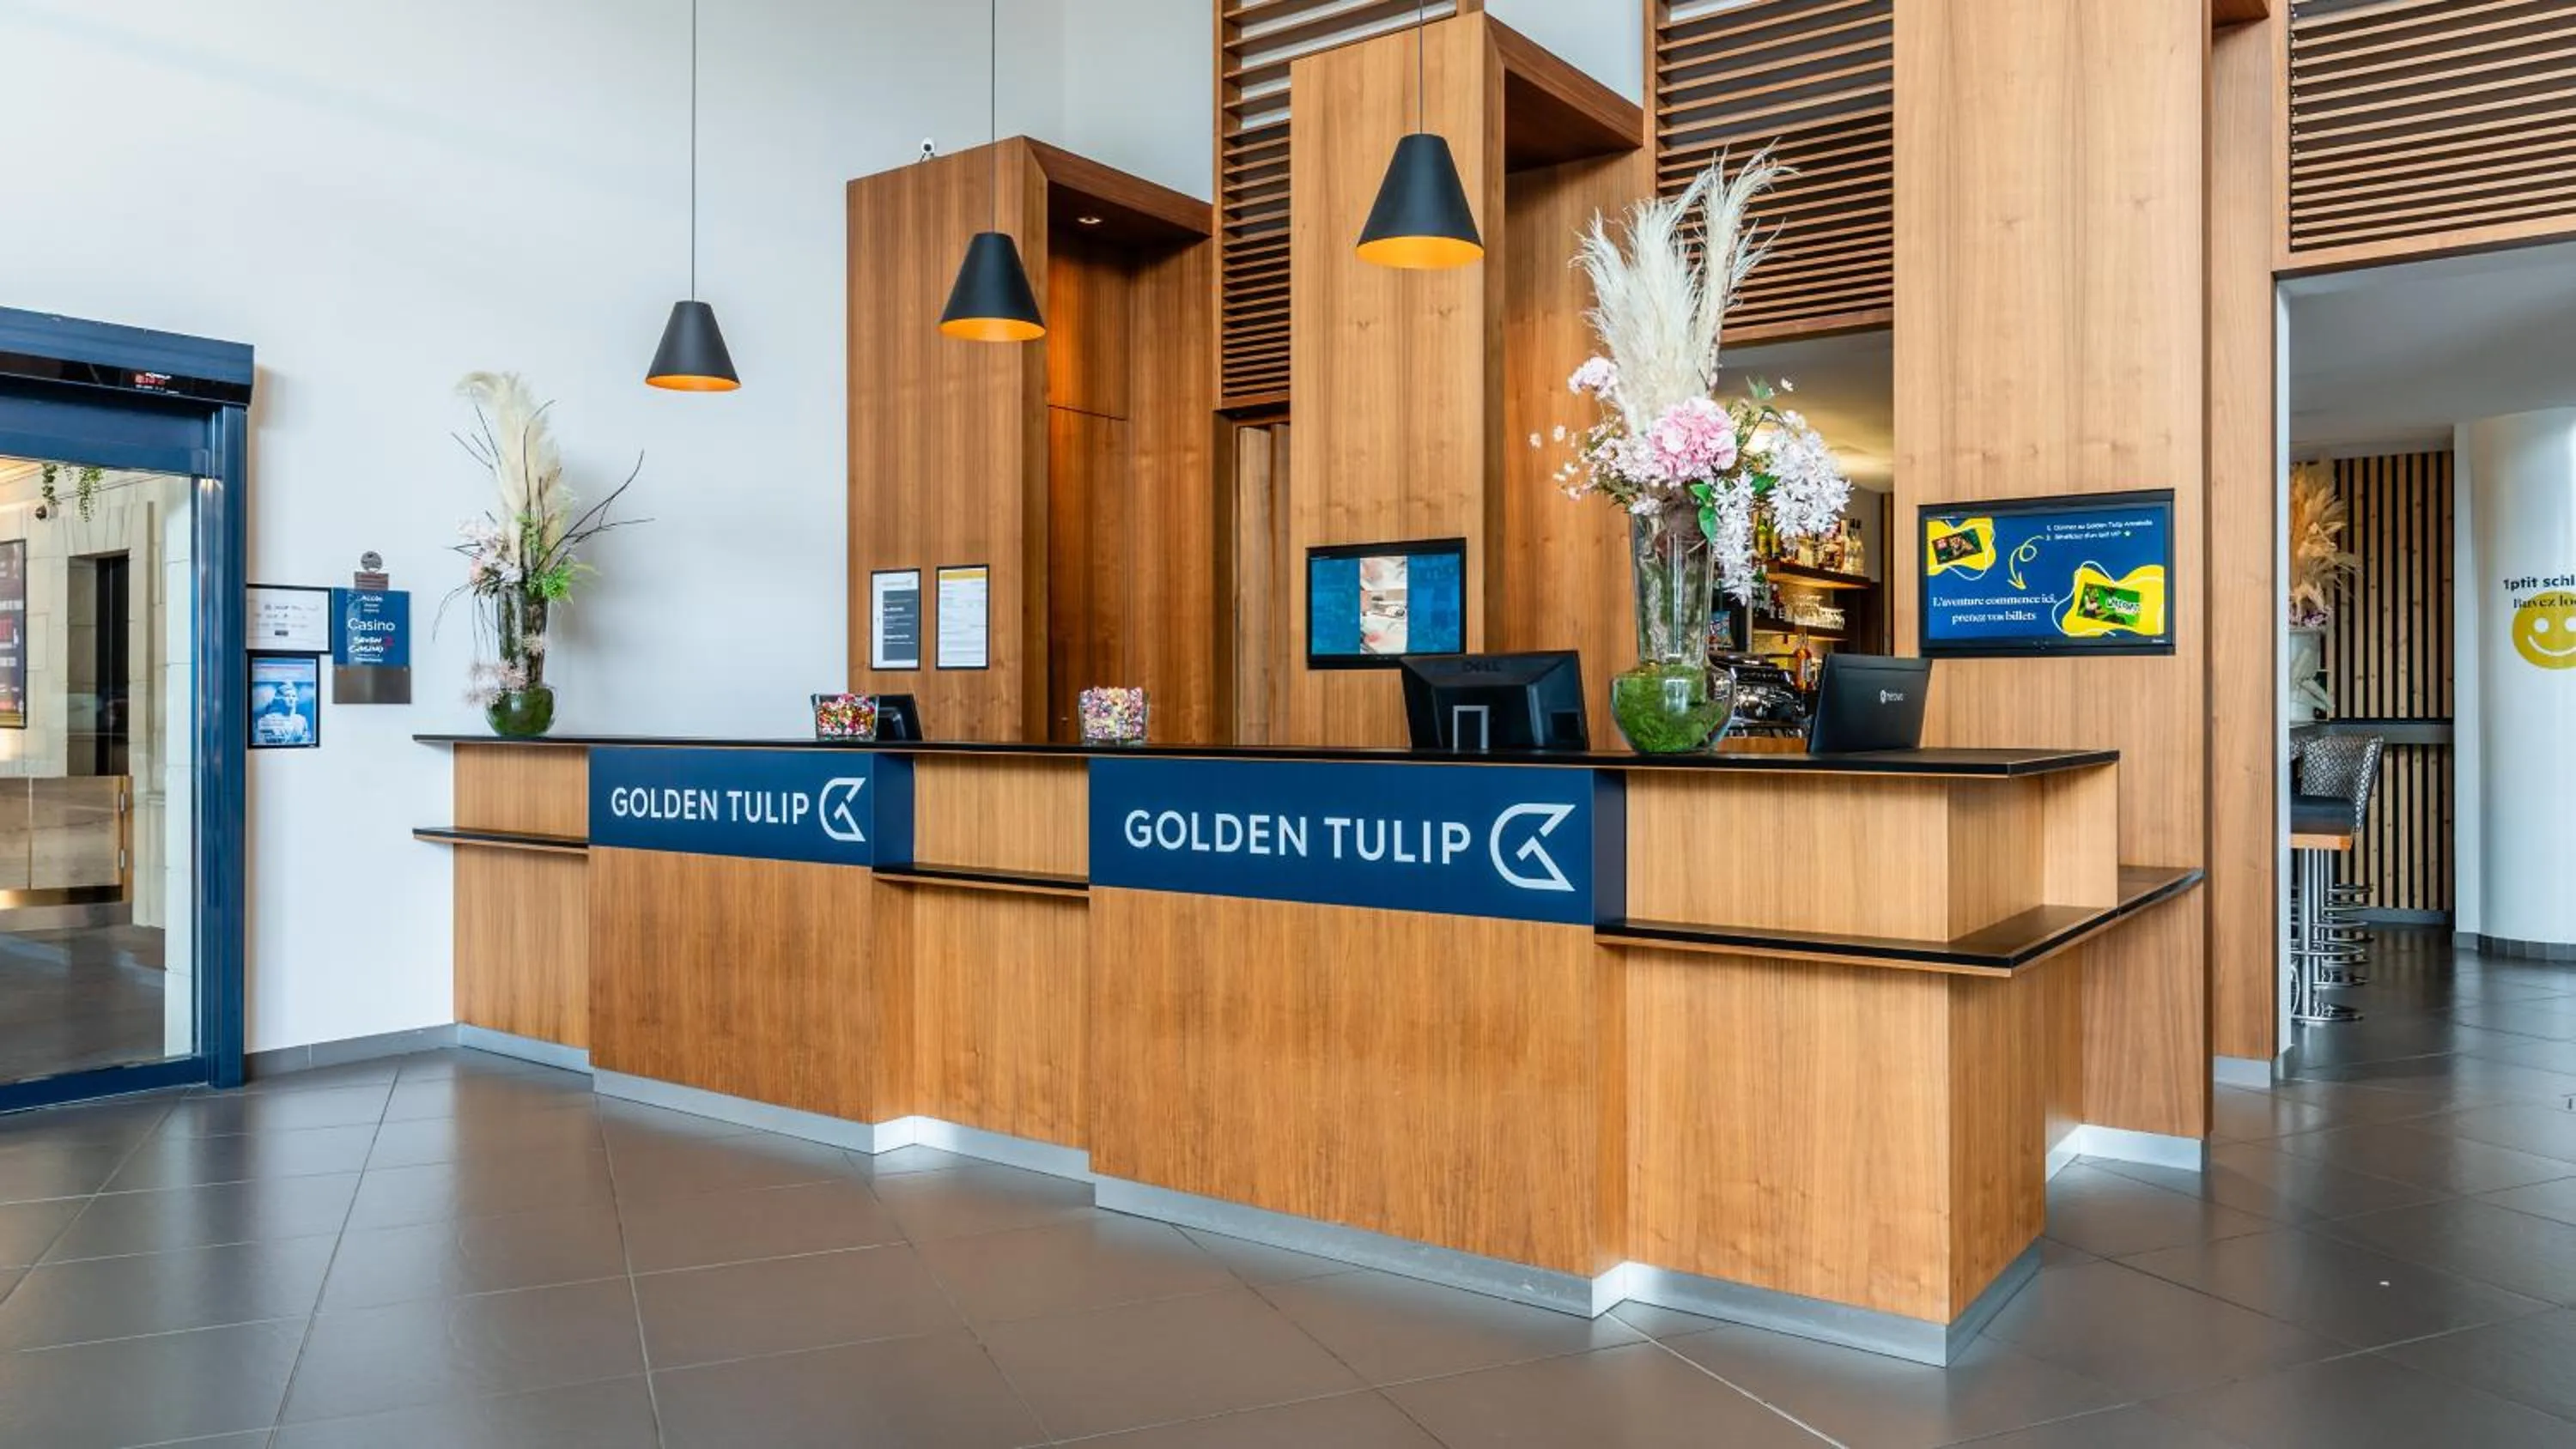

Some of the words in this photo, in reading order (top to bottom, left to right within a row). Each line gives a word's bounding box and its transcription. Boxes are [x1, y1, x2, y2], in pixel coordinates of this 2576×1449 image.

[2503, 577, 2537, 591] 1ptit
[1933, 597, 1984, 607] L'aventure
[2005, 610, 2037, 621] billets
[347, 617, 396, 632] Casino
[611, 786, 719, 822] GOLDEN
[726, 790, 810, 825] TULIP
[1124, 809, 1308, 858] GOLDEN
[1323, 816, 1472, 865] TULIP
